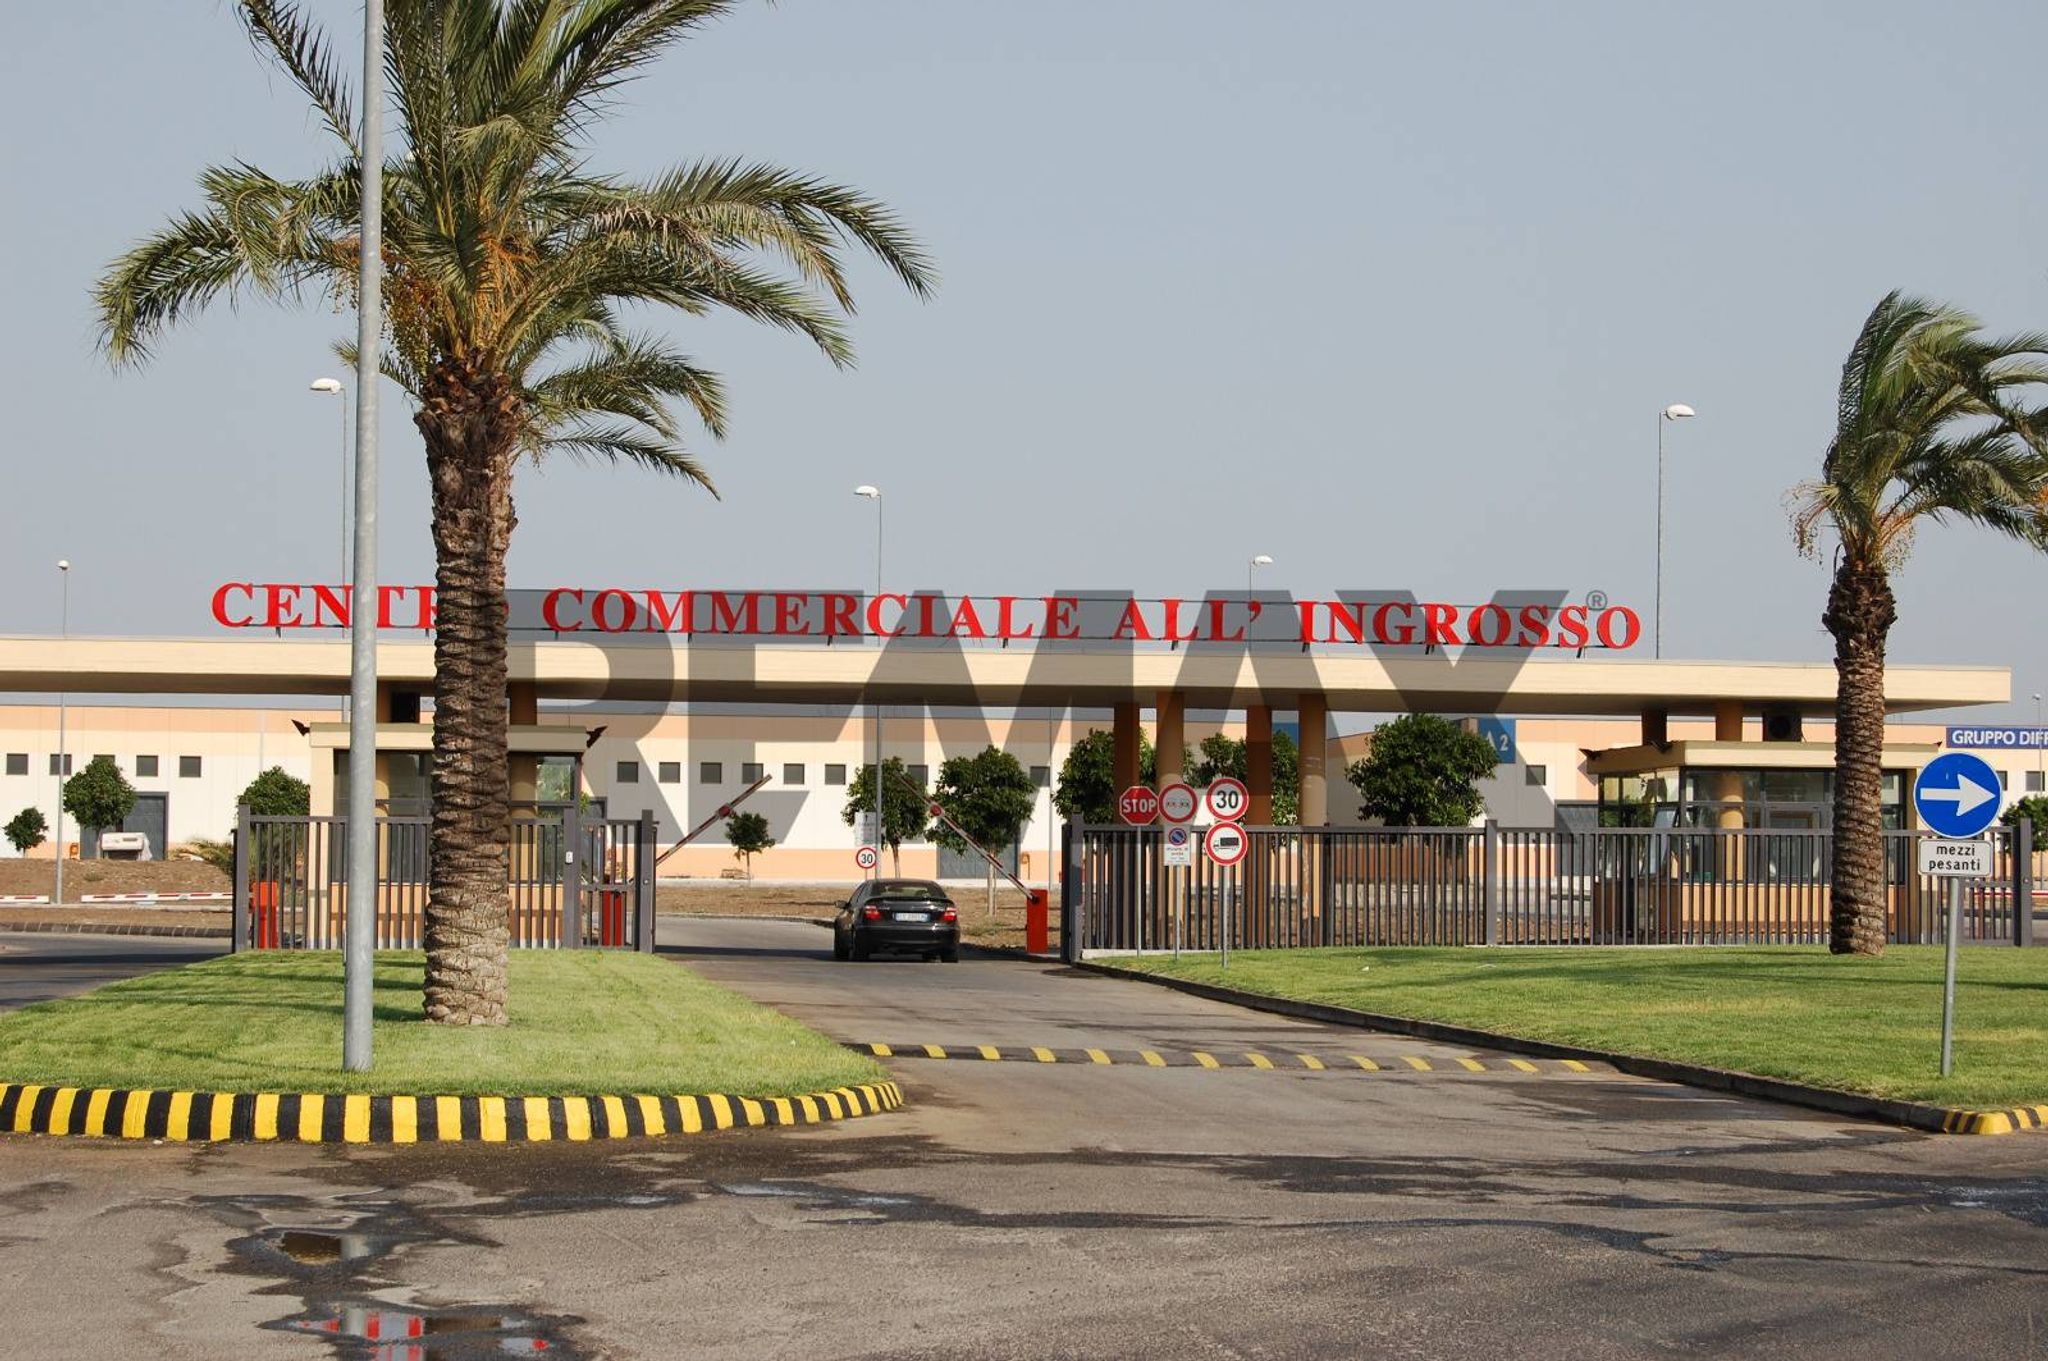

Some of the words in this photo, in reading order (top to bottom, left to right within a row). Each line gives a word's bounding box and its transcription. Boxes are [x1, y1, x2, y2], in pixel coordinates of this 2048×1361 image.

[543, 587, 1079, 639] COMMERCIALE
[1298, 600, 1641, 649] INGROSSO
[1952, 730, 2015, 745] GRUPPO
[1123, 799, 1157, 813] STOP
[1216, 790, 1239, 808] 30
[1936, 844, 1975, 856] mezzi
[861, 854, 873, 864] 30
[1929, 858, 1980, 871] pesanti
